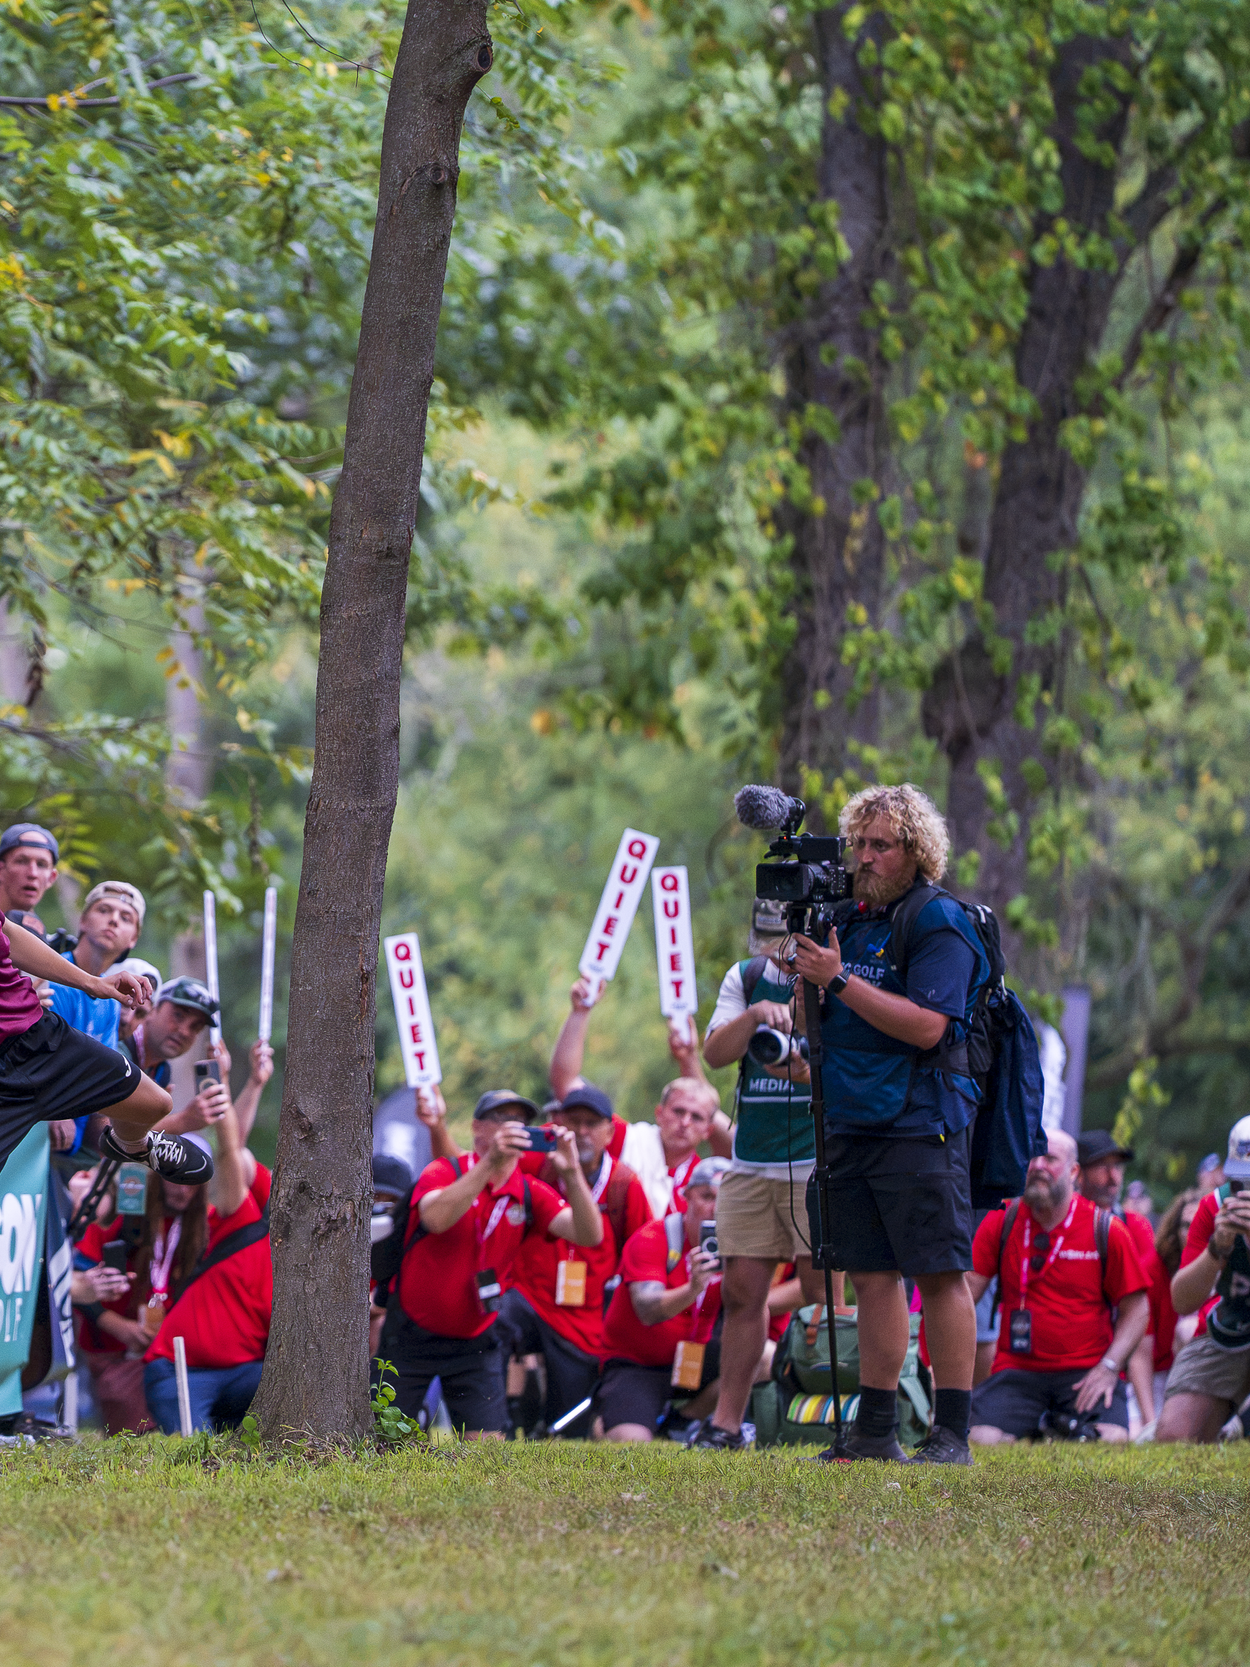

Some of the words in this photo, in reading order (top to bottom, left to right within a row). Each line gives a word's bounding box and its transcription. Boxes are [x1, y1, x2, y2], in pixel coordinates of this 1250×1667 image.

[597, 840, 647, 961] QUIET
[660, 873, 683, 998] QUIET
[394, 942, 425, 1071] QUIET
[853, 963, 885, 980] GOLF
[749, 1077, 796, 1093] MEDIA
